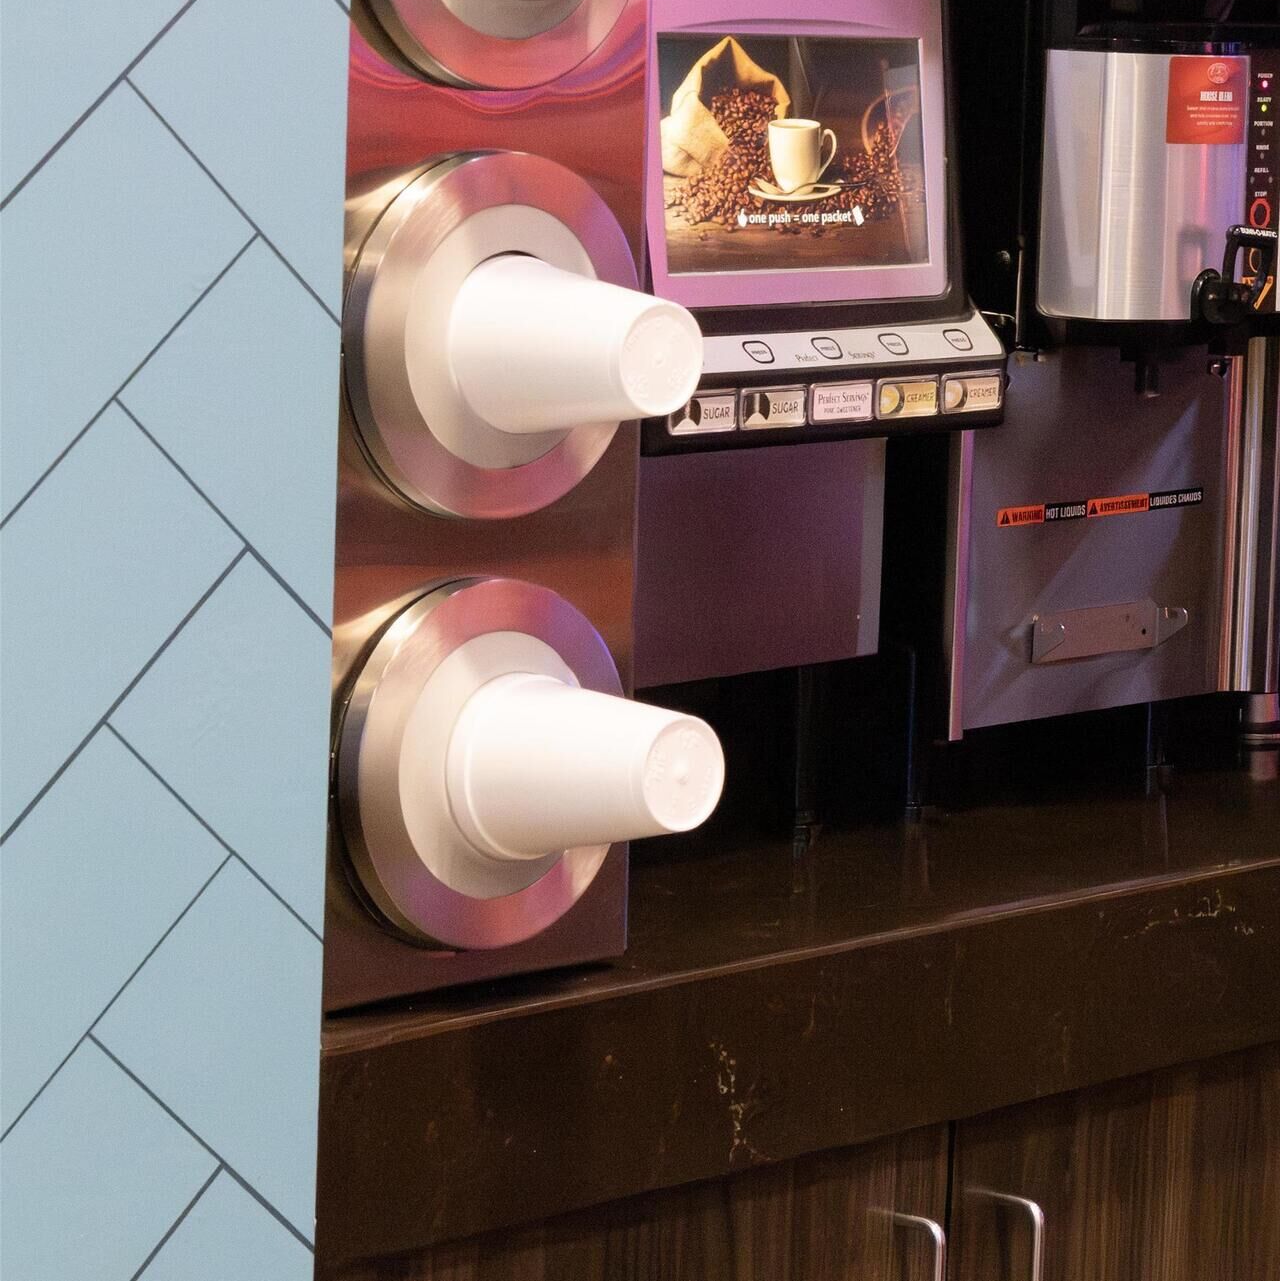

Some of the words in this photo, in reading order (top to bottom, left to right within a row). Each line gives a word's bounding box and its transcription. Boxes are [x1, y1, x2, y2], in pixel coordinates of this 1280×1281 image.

[748, 213, 767, 224] one
[768, 210, 791, 227] push
[801, 213, 820, 223] one
[821, 209, 852, 226] packet
[905, 392, 935, 404] CREAMER
[968, 387, 997, 399] CREAMER
[702, 406, 731, 421] SUGAR
[771, 401, 799, 415] SUGAR
[1012, 508, 1043, 523] WARNING
[1045, 507, 1060, 519] HOT
[1060, 504, 1086, 518] LIQUIDS
[1150, 493, 1177, 507] LIQUIDES
[1177, 490, 1202, 504] CHAUDS
